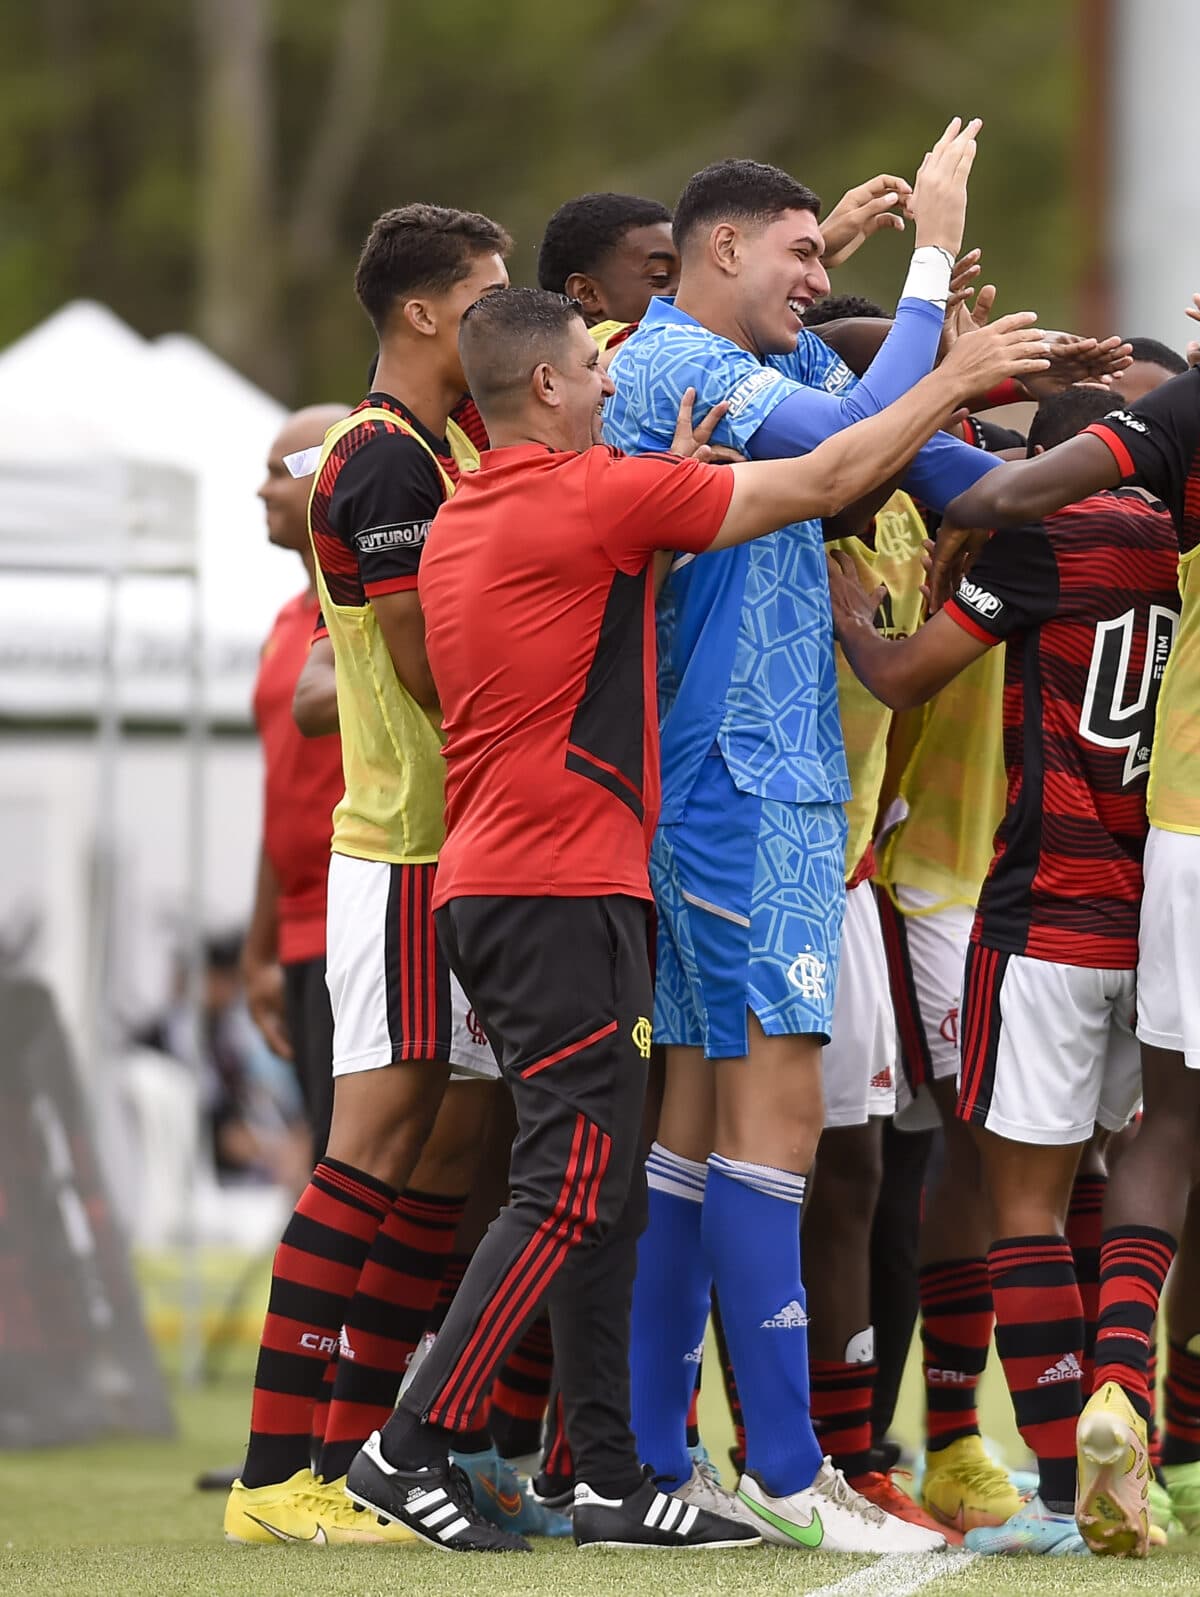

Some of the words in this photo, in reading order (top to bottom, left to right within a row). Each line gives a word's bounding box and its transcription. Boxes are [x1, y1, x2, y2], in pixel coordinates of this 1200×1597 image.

[1154, 635, 1170, 662] TIM
[760, 1317, 811, 1330] adida
[299, 1333, 340, 1353] CR
